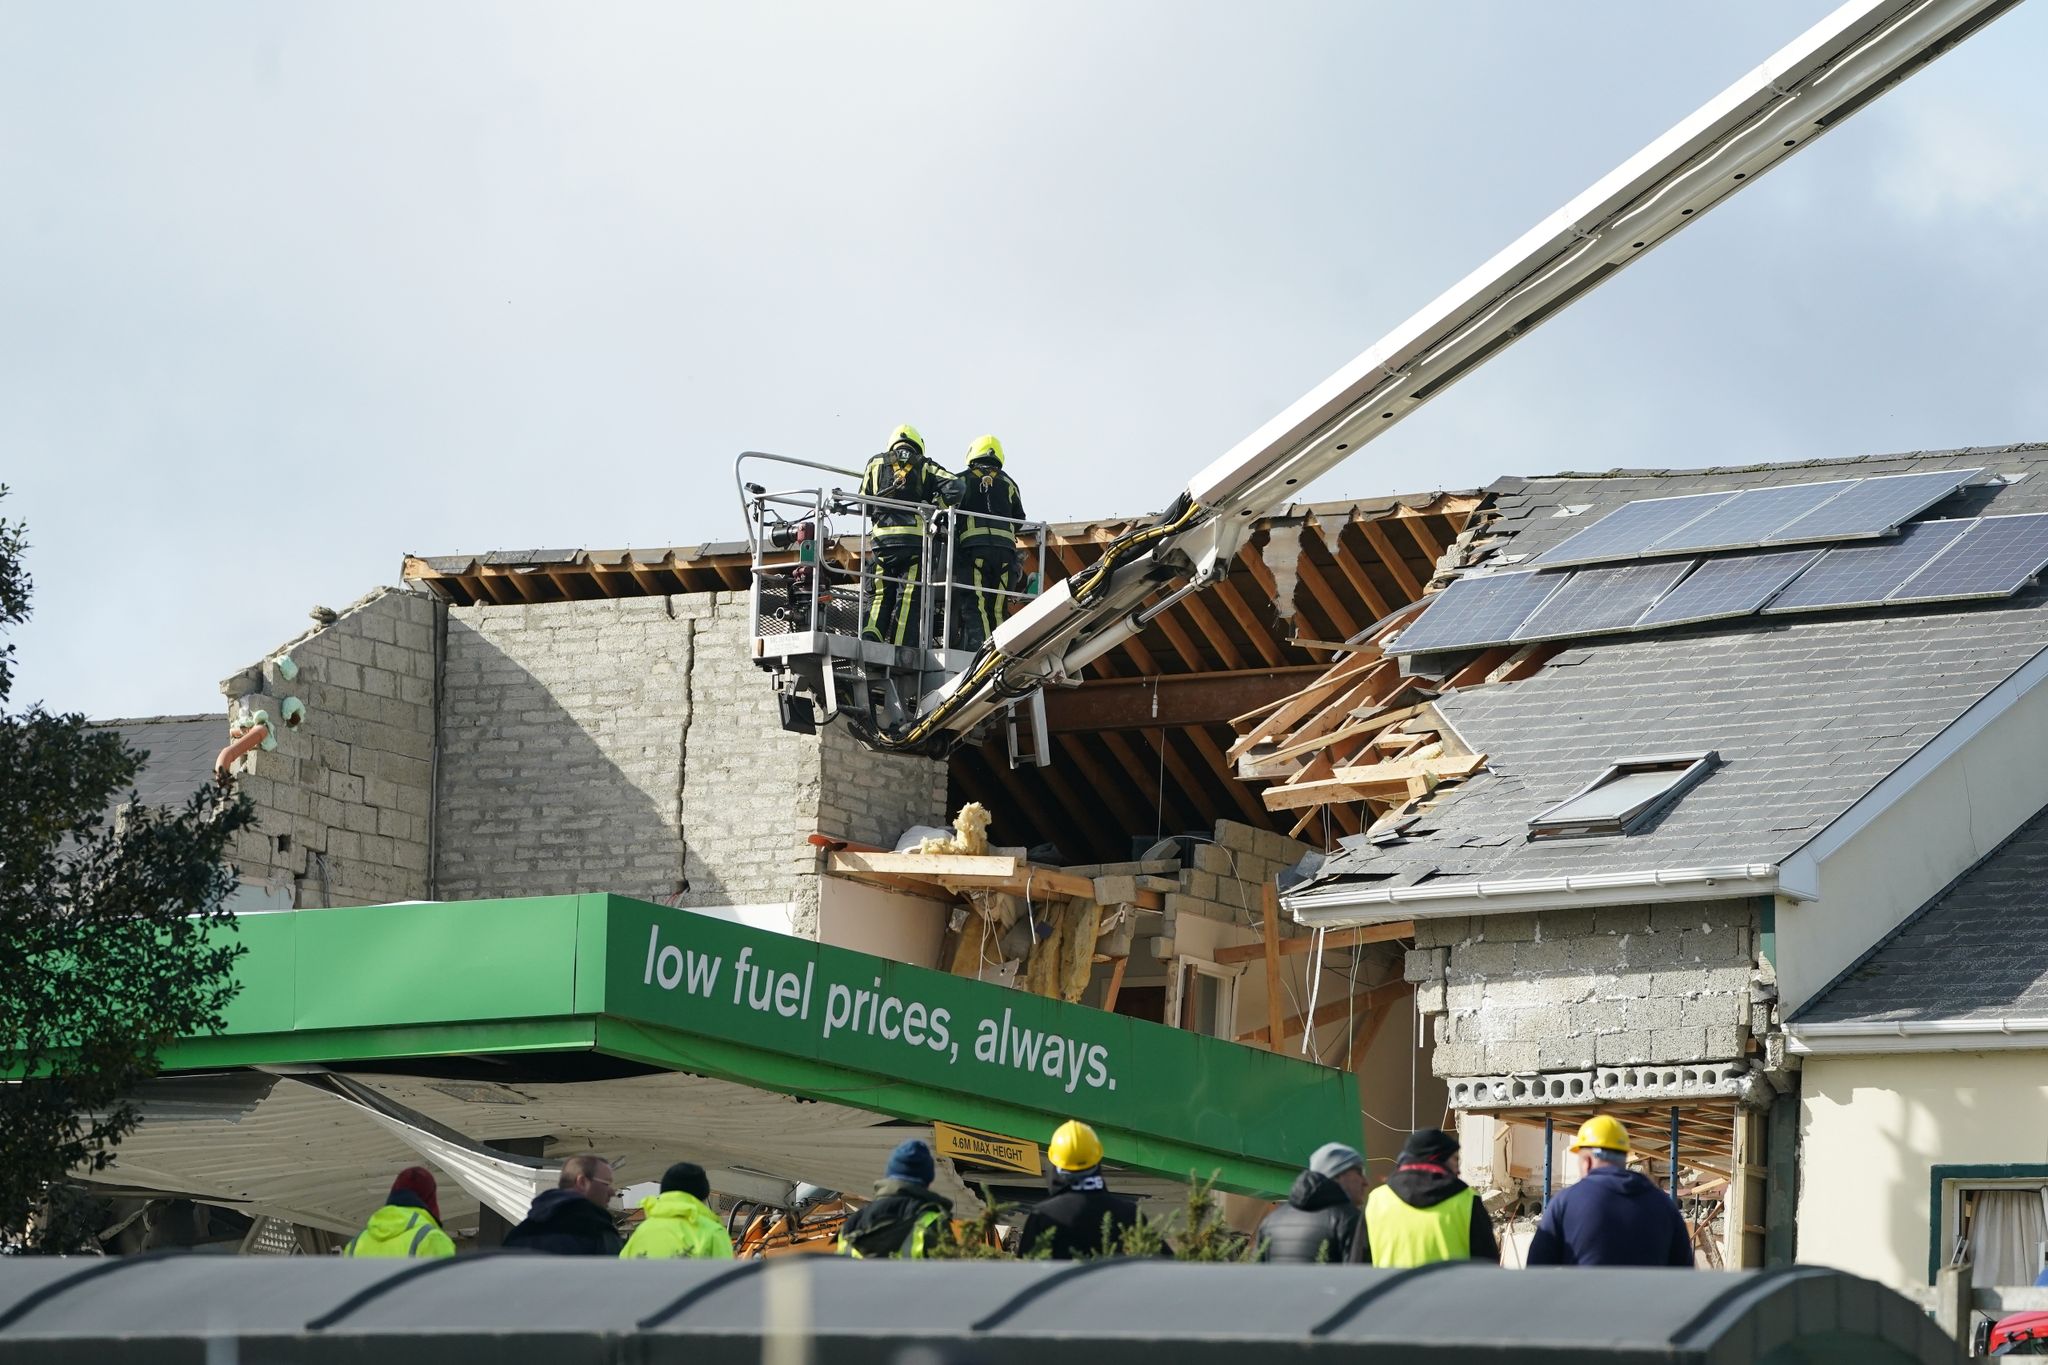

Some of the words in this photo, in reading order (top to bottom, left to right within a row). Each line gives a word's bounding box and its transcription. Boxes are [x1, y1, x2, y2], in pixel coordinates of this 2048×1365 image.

[643, 924, 722, 998] low
[733, 946, 815, 1020] fuel
[822, 976, 959, 1065] prices,
[974, 1007, 1117, 1094] always.
[952, 1136, 971, 1150] 4.6M
[973, 1140, 991, 1155] MAX
[992, 1144, 1024, 1162] HEIGHT
